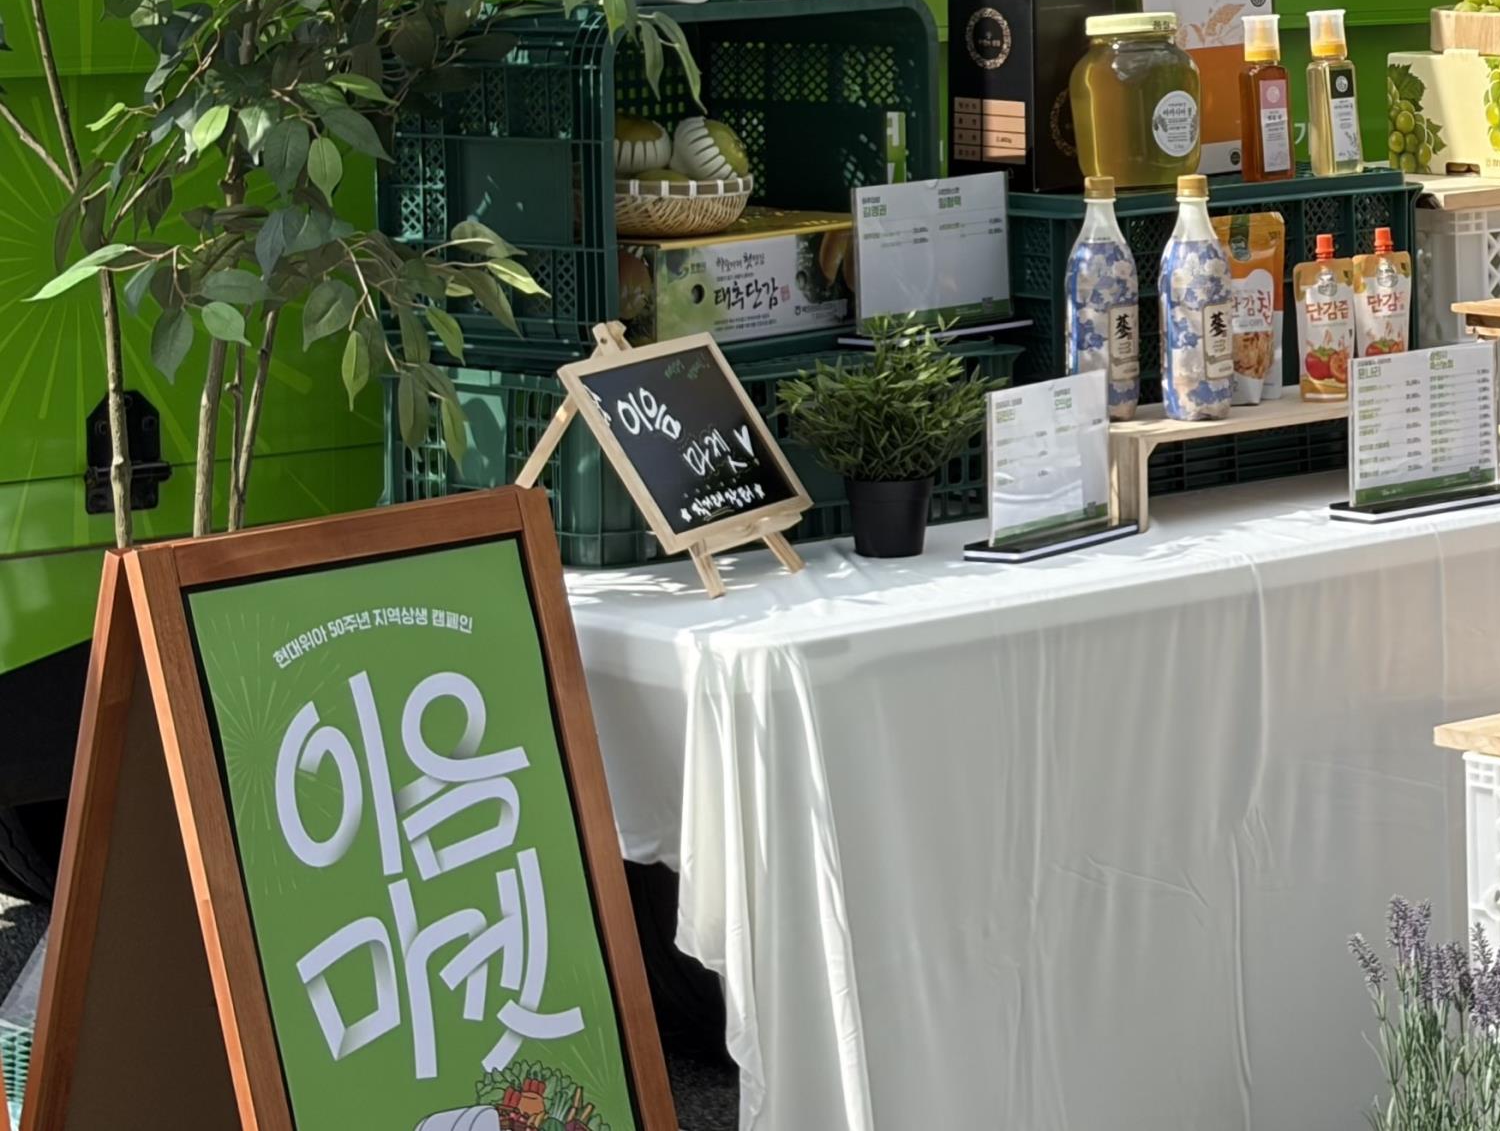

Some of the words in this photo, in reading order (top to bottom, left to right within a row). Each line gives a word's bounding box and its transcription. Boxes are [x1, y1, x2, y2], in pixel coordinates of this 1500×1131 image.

[713, 277, 780, 311] 태추단감
[1305, 299, 1350, 323] 단감즙
[616, 386, 682, 440] 이음
[272, 624, 329, 669] 현대위아
[327, 610, 372, 638] 50주년
[372, 606, 428, 626] 지역상생
[431, 608, 474, 635] 캠페인
[275, 671, 531, 881] 이음
[297, 847, 585, 1079] 마켓
